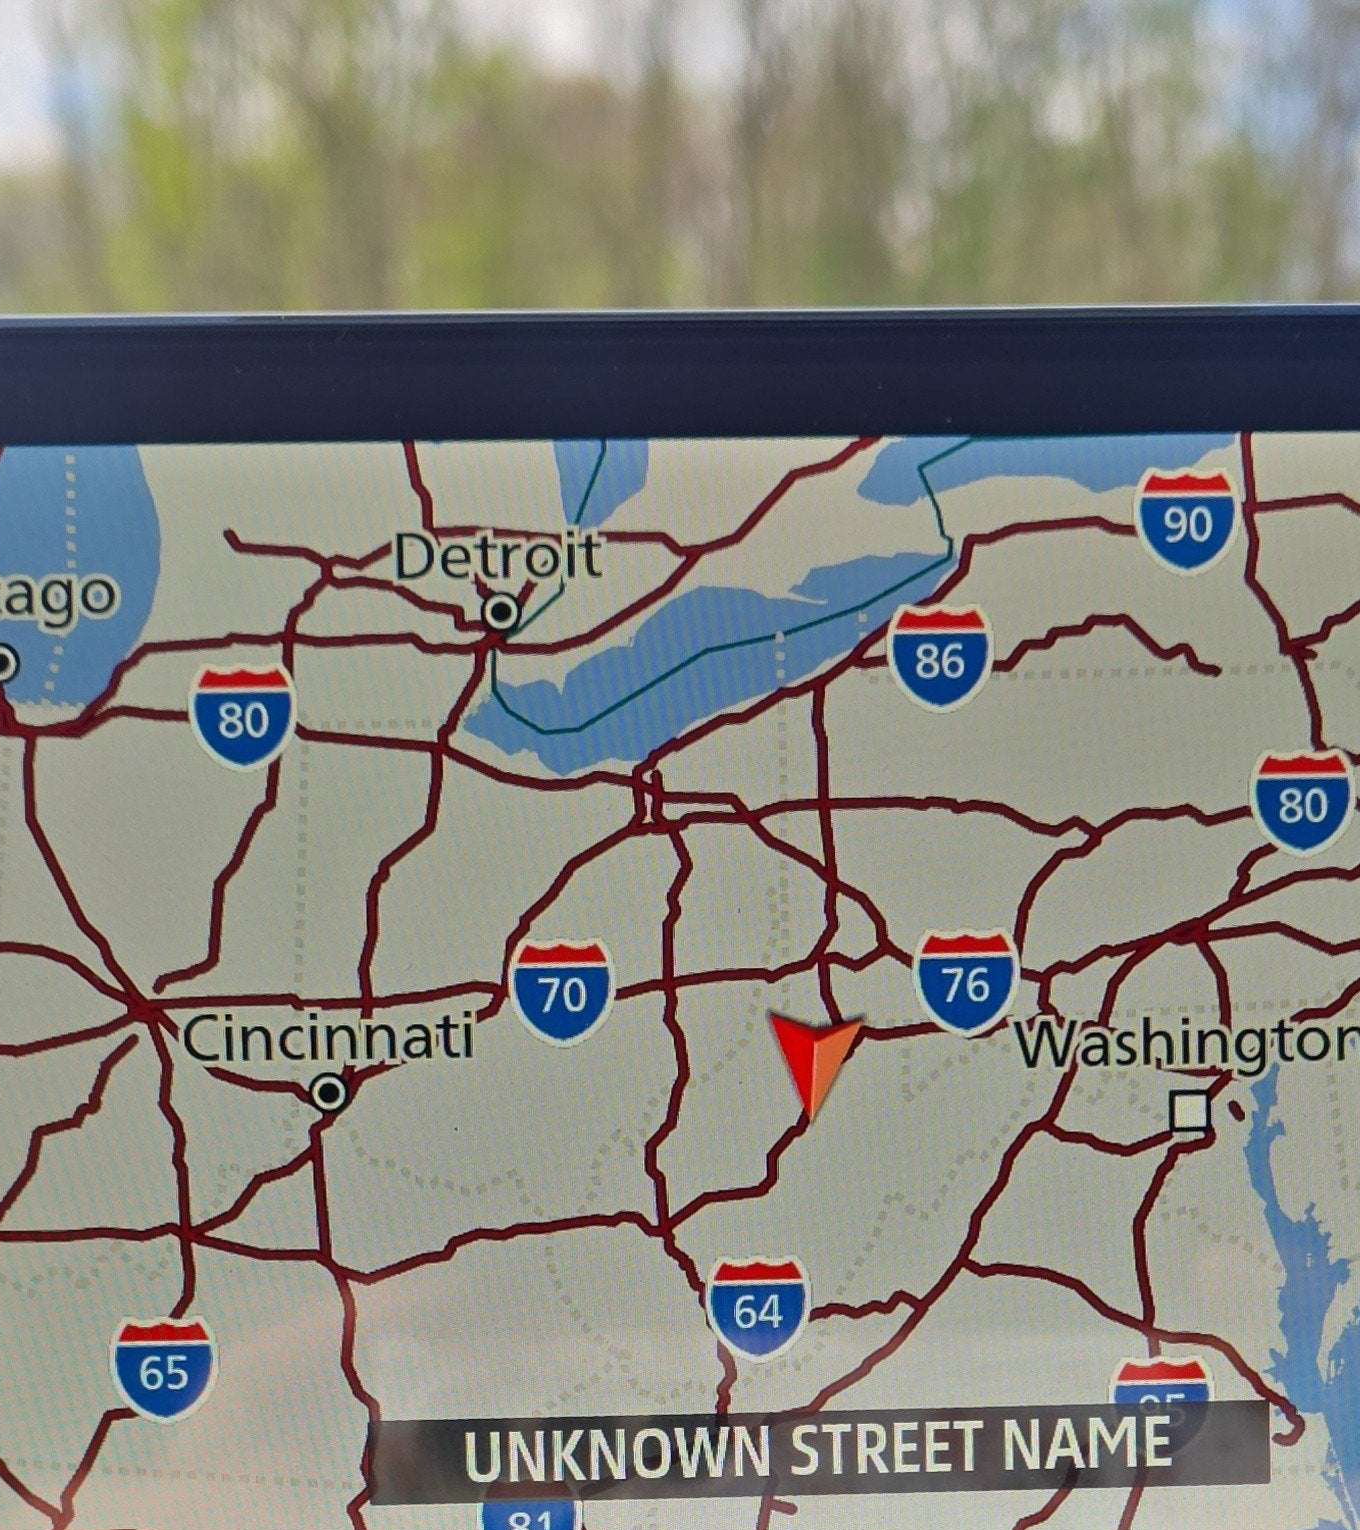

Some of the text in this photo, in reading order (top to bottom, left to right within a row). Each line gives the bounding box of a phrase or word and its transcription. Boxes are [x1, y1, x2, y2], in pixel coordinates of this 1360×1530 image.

[1162, 505, 1213, 543] 90
[394, 532, 603, 580] Detroit
[914, 642, 966, 680] 86
[217, 703, 270, 740] 80
[1278, 787, 1328, 823] 80
[537, 979, 587, 1014] 70
[941, 967, 991, 1003] 76
[182, 1010, 476, 1062] Cincinnati
[735, 1293, 784, 1330] 64
[139, 1354, 190, 1392] 65
[464, 1414, 1174, 1485] UNKNOWN STREET NAME
